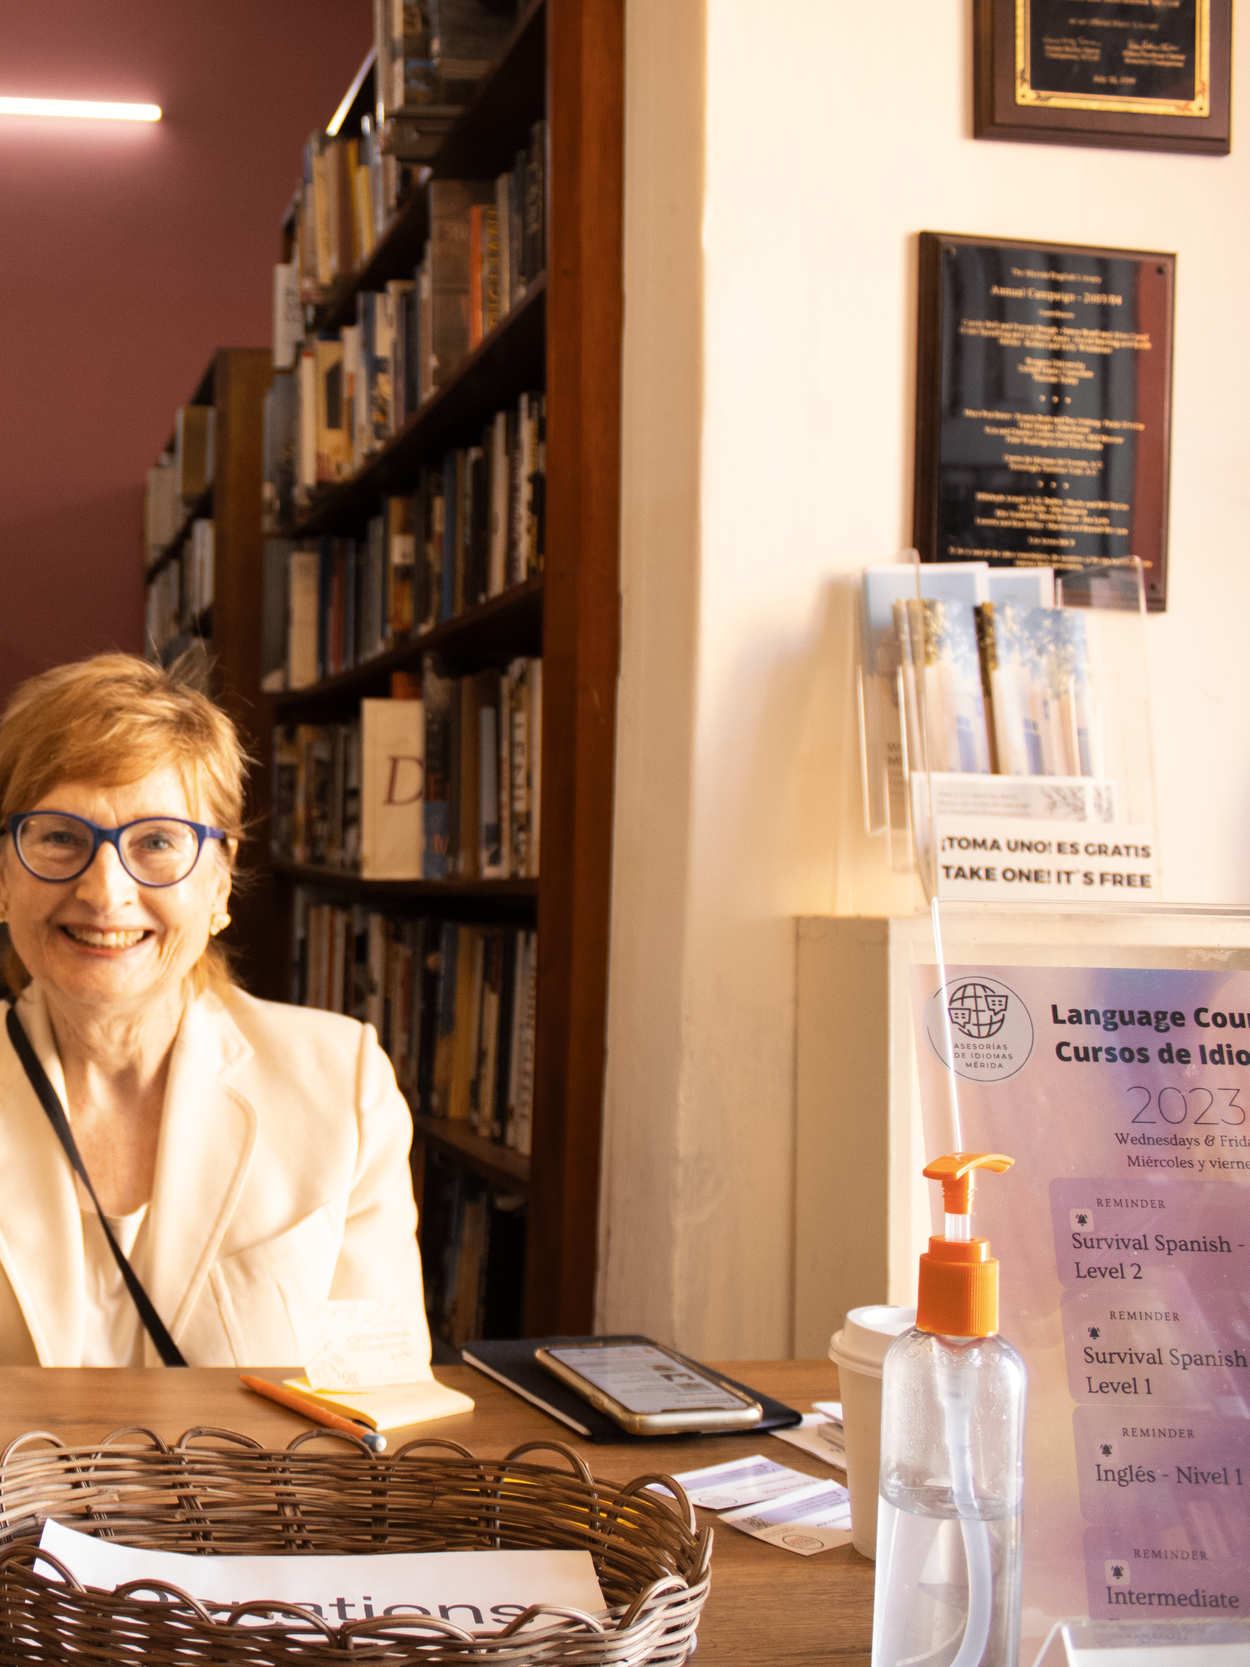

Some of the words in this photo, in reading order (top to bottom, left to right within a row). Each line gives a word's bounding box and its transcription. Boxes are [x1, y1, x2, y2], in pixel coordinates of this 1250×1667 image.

[1006, 840, 1052, 854] UNO!
[1056, 841, 1080, 855] ES
[1084, 843, 1152, 858] GRATIS
[941, 865, 997, 882] TAKE
[1002, 867, 1051, 884] ONE!
[1099, 872, 1152, 889] FREE
[1051, 1004, 1186, 1033] Language
[970, 1052, 1013, 1060] IDIOMAS
[1055, 1041, 1150, 1065] Cursos
[1158, 1042, 1191, 1065] de
[1199, 1044, 1250, 1066] Idio
[965, 1060, 1004, 1069] MÉRIDA
[1126, 1085, 1246, 1125] 2023
[1114, 1131, 1201, 1149] Wednesdays
[1204, 1134, 1216, 1148] &
[1127, 1154, 1194, 1170] Miércoles
[1198, 1160, 1205, 1172] y
[1096, 1198, 1166, 1210] REMINDER
[1071, 1232, 1150, 1251] Survival
[1155, 1235, 1232, 1255] Spanish
[1075, 1261, 1125, 1280] Level
[1132, 1263, 1143, 1280] 2
[1109, 1310, 1181, 1322] REMINDER
[1083, 1346, 1164, 1365] Survival
[1169, 1348, 1248, 1371] Spanish
[1086, 1376, 1139, 1395] Level
[1144, 1378, 1153, 1395] 1
[1122, 1427, 1196, 1440] REMINDER
[1095, 1464, 1156, 1488] Inglés
[1176, 1465, 1230, 1485] Nivel
[1235, 1468, 1244, 1486] 1
[1133, 1548, 1209, 1562] REMINDER
[1106, 1586, 1240, 1609] Intermediate
